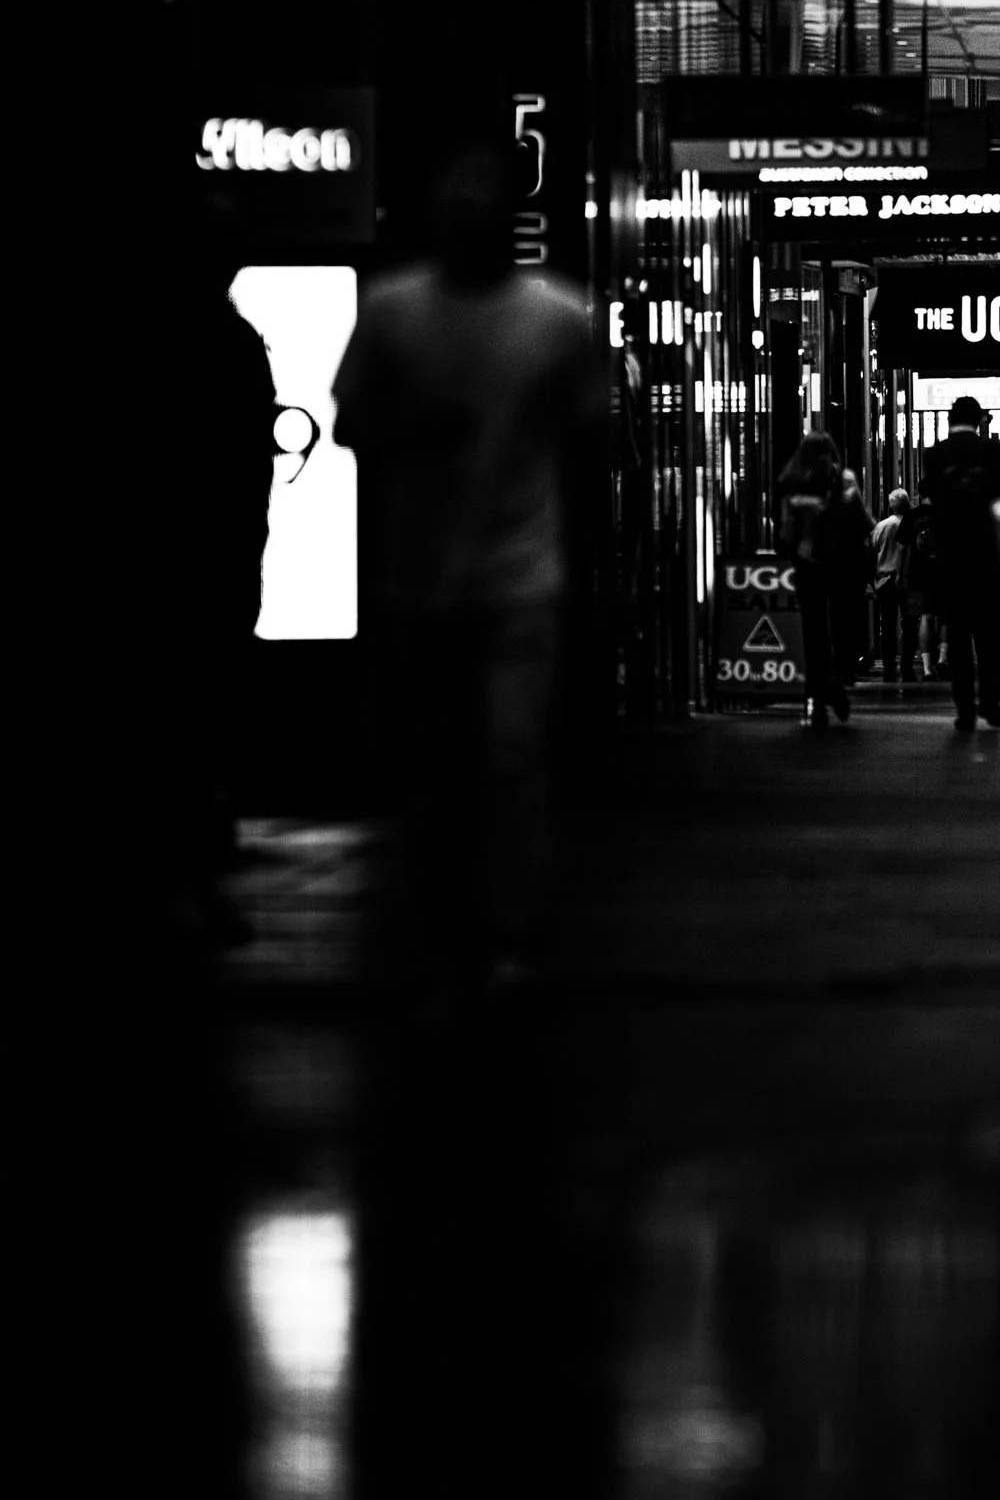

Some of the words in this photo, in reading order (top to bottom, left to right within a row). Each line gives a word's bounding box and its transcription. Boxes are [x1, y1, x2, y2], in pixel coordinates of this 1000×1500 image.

[773, 196, 868, 218] PETER
[878, 194, 1000, 219] JACKSON
[914, 307, 954, 330] THE
[715, 658, 751, 682] 30
